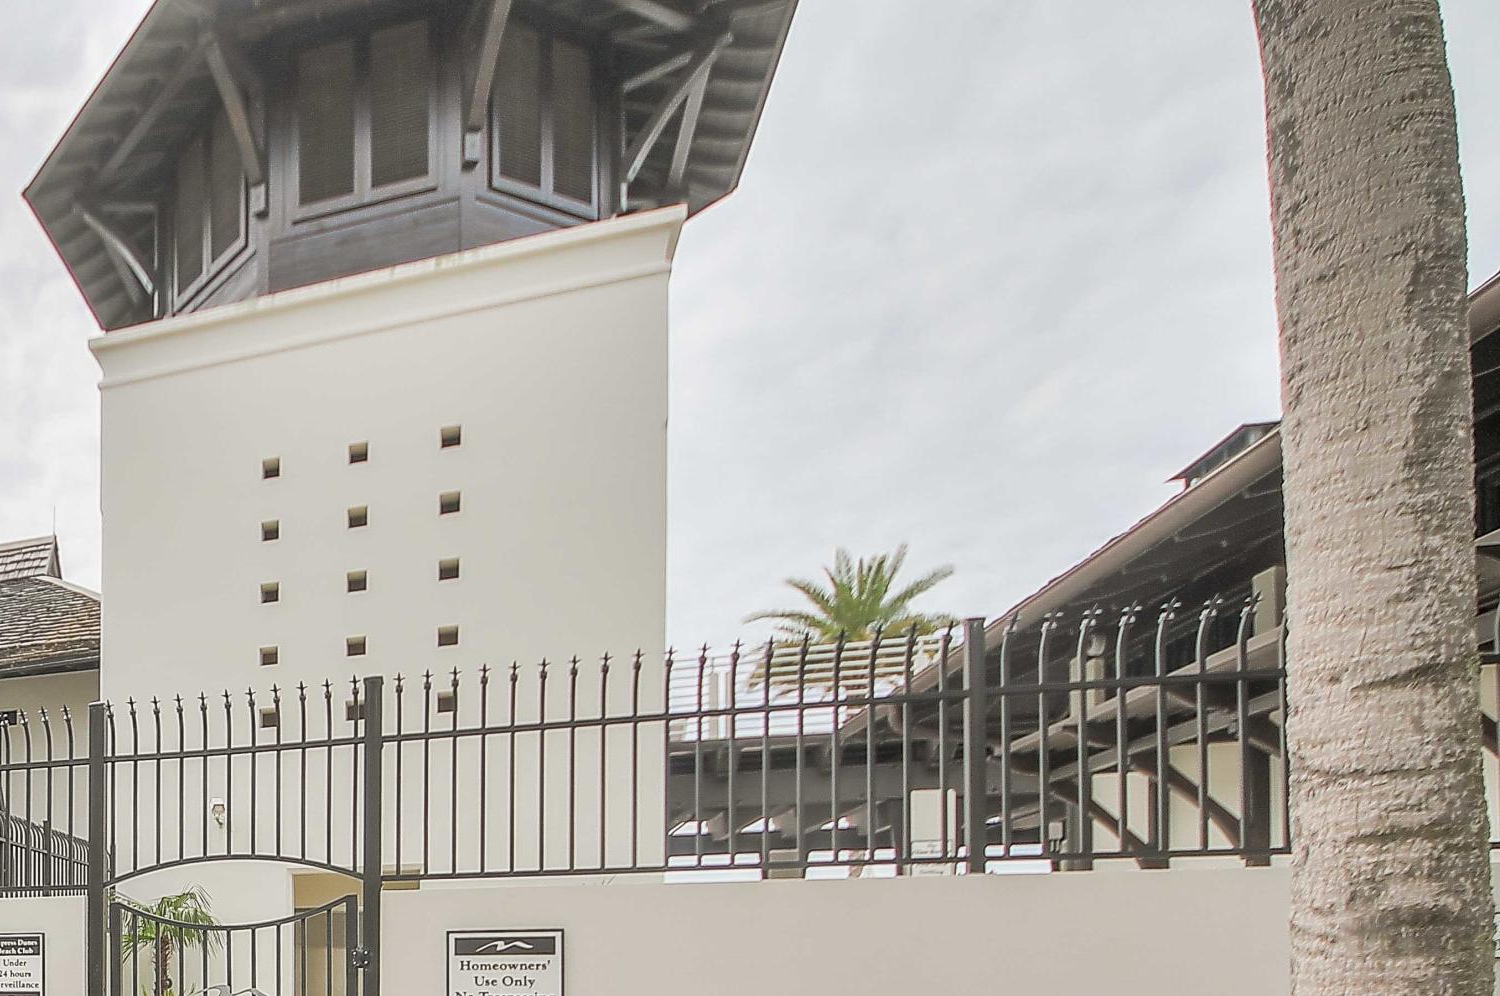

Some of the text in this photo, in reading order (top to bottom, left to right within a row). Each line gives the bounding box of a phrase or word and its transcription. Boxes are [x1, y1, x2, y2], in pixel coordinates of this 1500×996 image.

[460, 960, 550, 971] Homeowners'
[474, 975, 535, 988] Use Only
